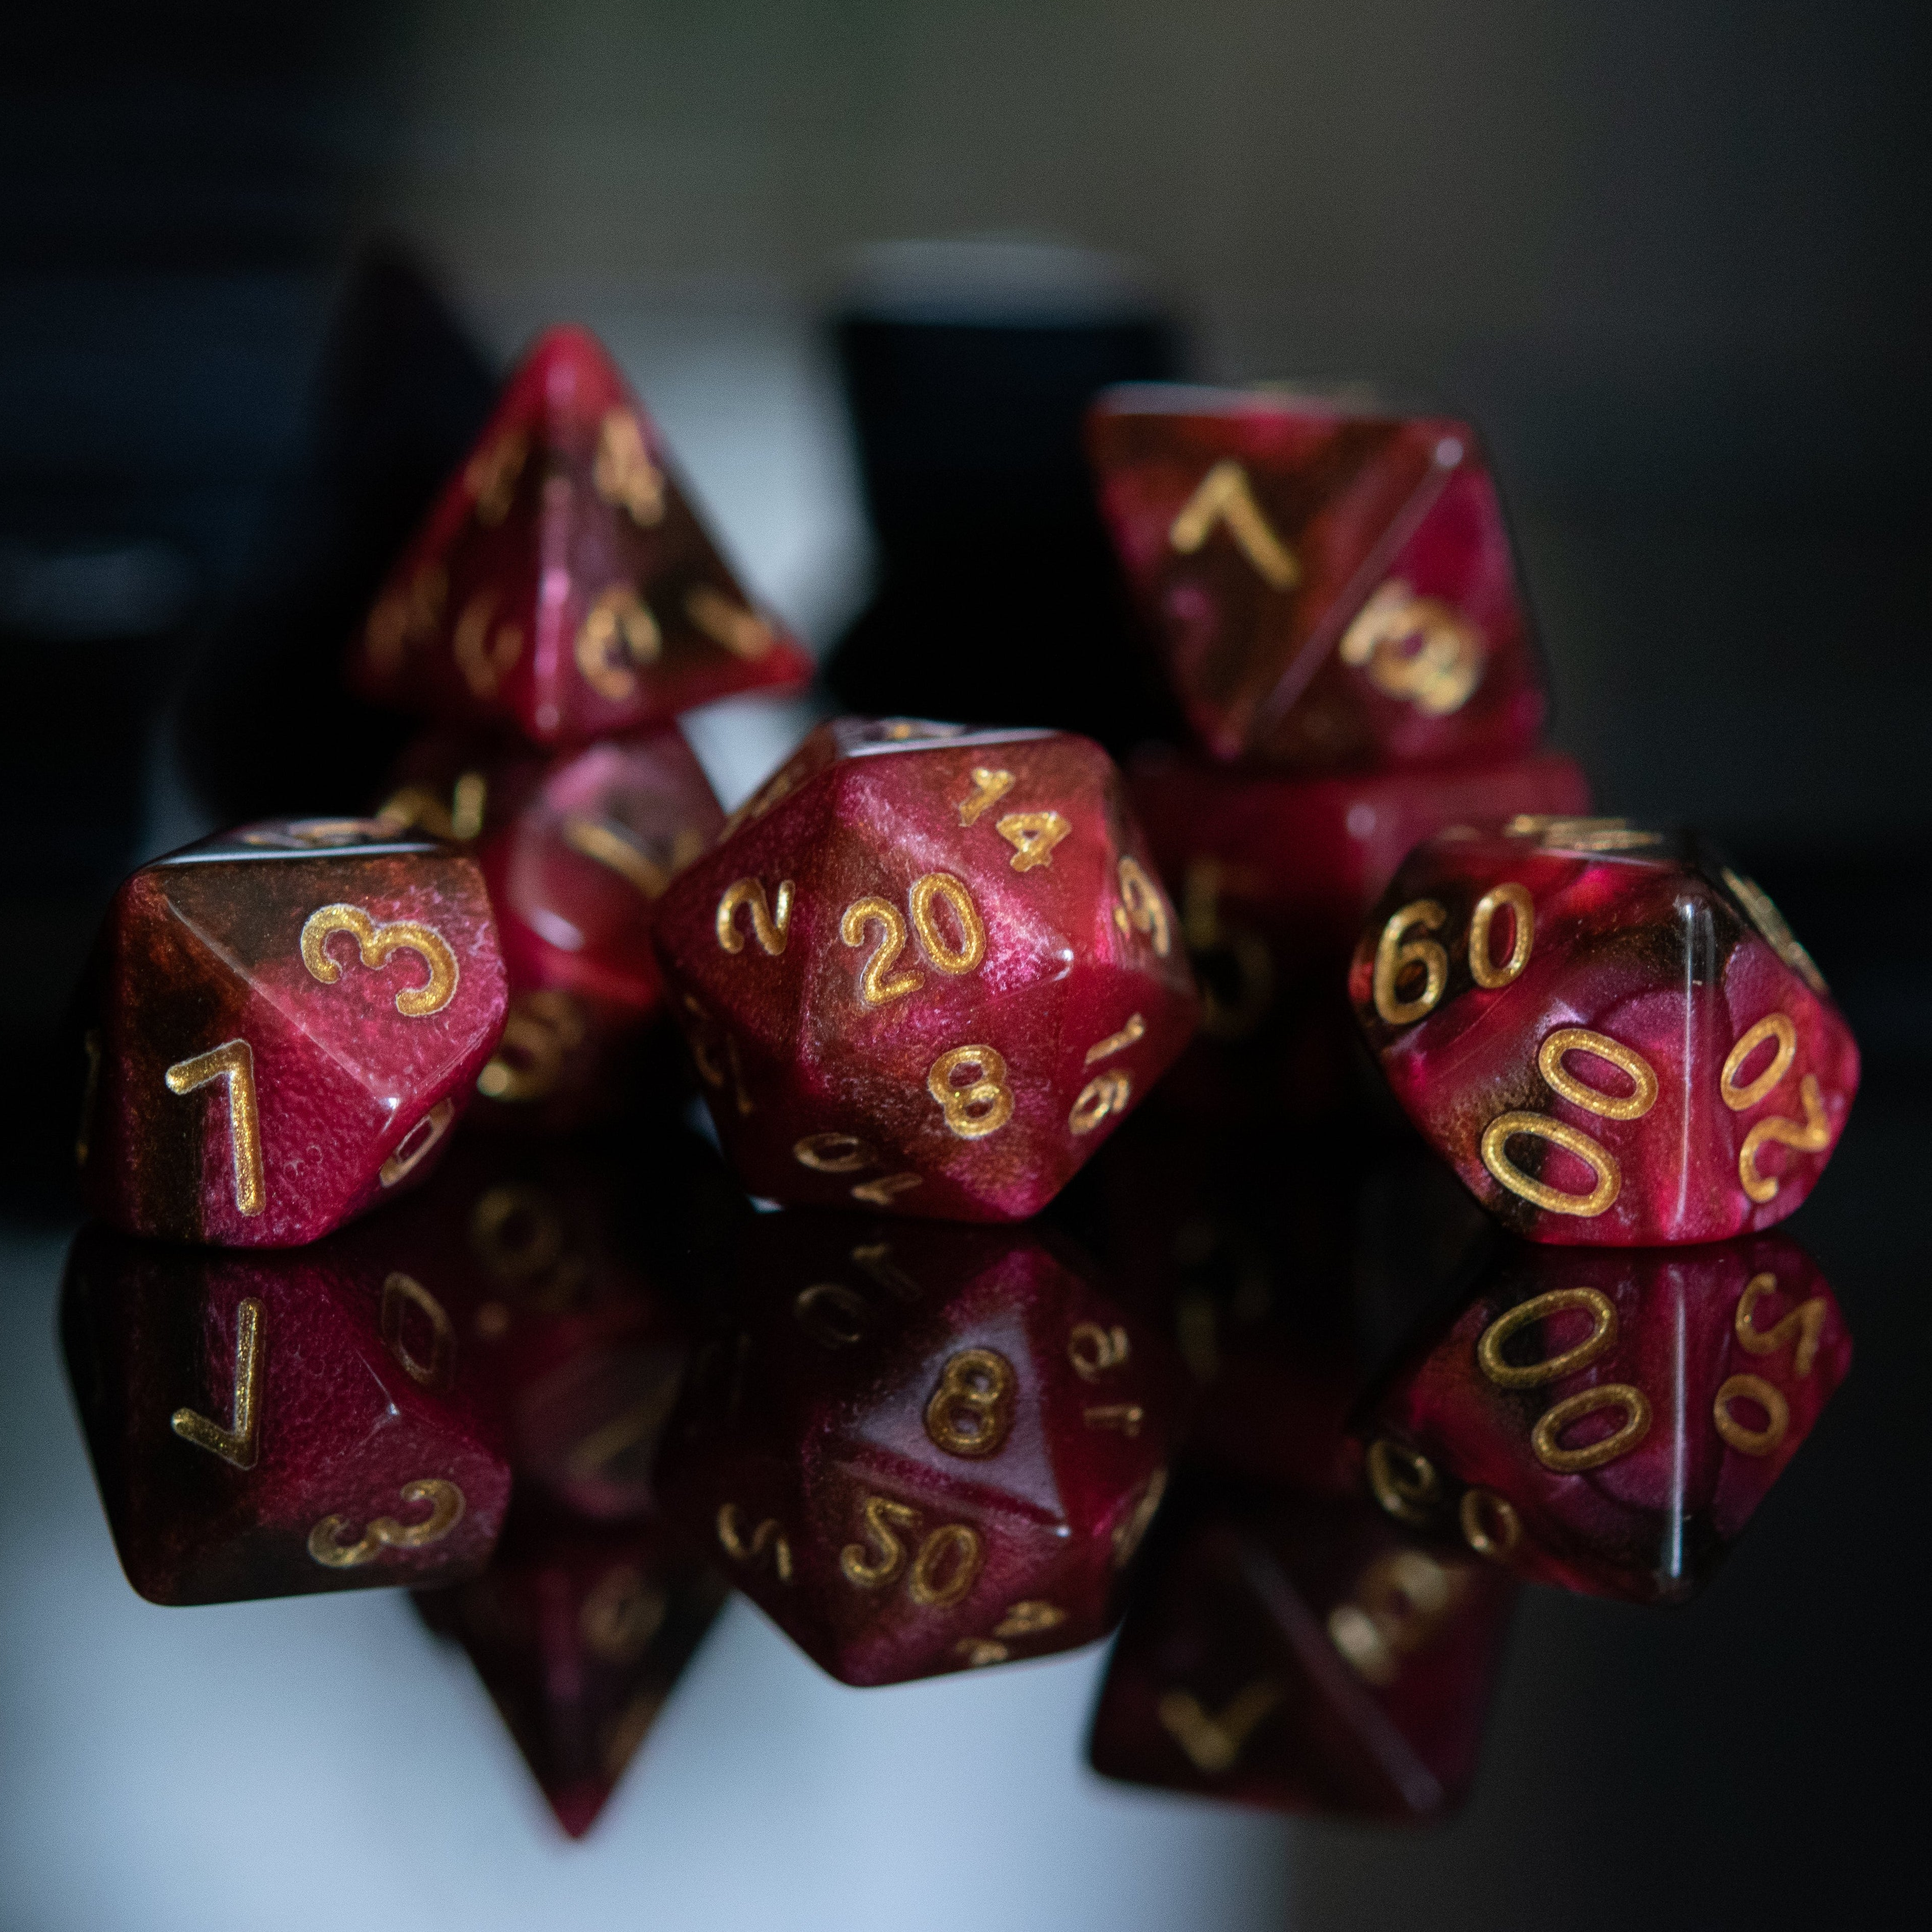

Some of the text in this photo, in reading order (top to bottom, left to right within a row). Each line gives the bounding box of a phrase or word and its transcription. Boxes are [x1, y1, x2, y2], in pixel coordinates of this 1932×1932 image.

[958, 767, 1071, 872] 14
[301, 903, 459, 1016] 3
[716, 877, 796, 955] 2
[841, 873, 986, 1006] 20
[1372, 882, 1534, 1027] 60
[165, 1038, 266, 1216] 7
[928, 1045, 1015, 1139] 8
[1480, 1028, 1659, 1217] 00
[1720, 1012, 1832, 1203] 20
